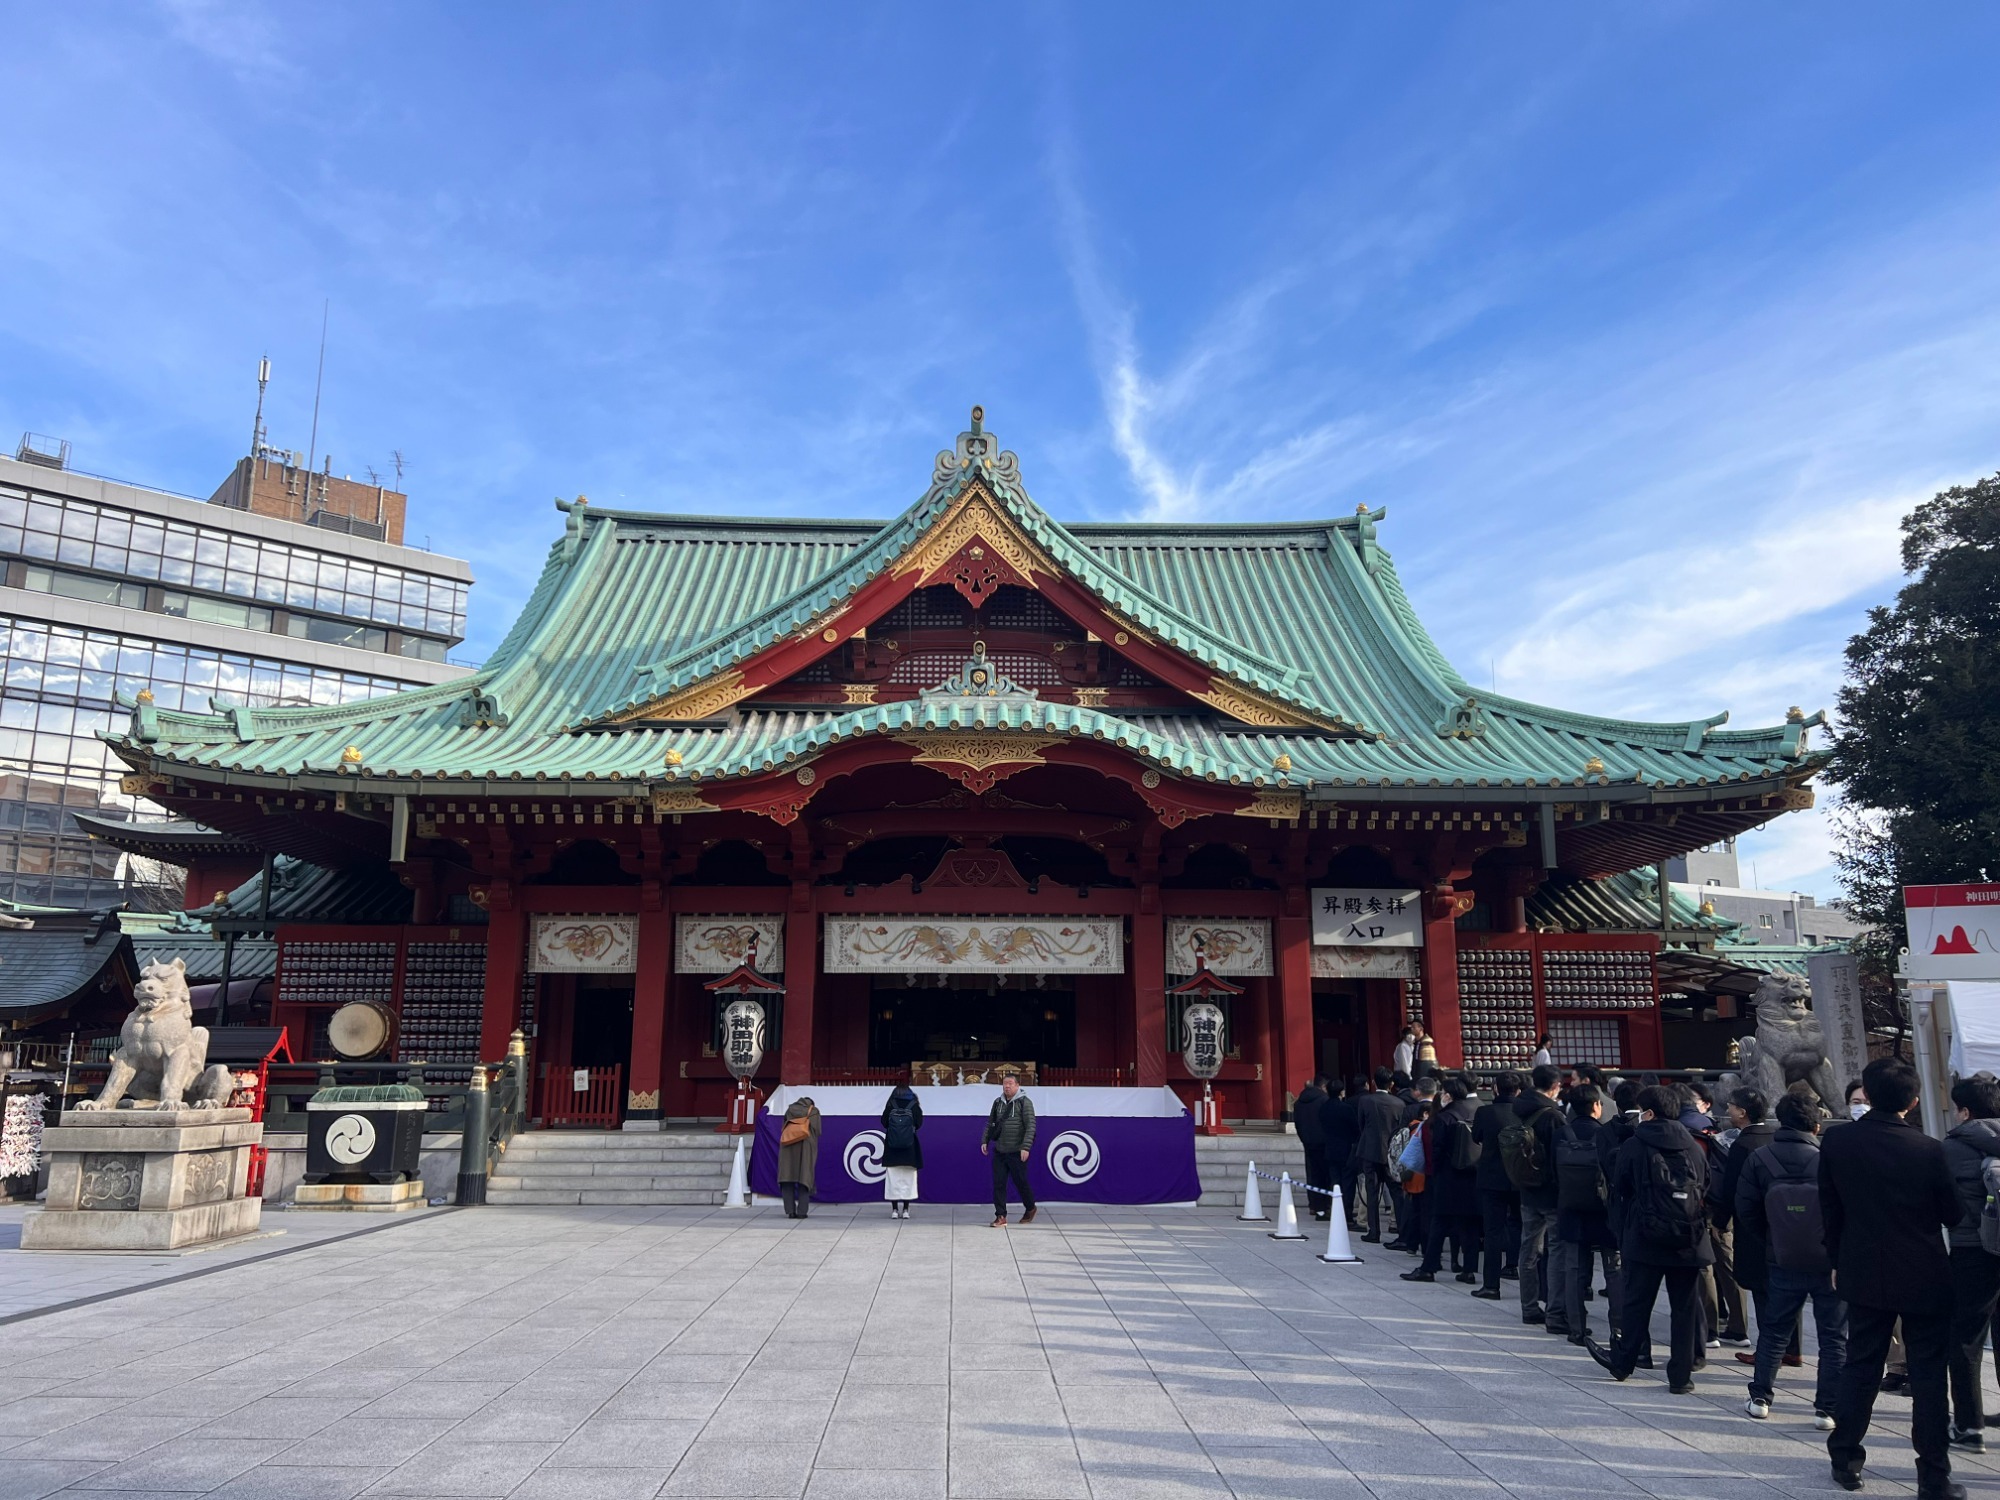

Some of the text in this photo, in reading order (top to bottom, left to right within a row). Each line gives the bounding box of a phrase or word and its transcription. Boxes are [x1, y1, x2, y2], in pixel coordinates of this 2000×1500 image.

[1322, 896, 1407, 915] 昇殿参拝
[1346, 923, 1385, 939] 入口
[731, 1015, 755, 1064] 神田明神
[1193, 1017, 1216, 1068] 神田明神
